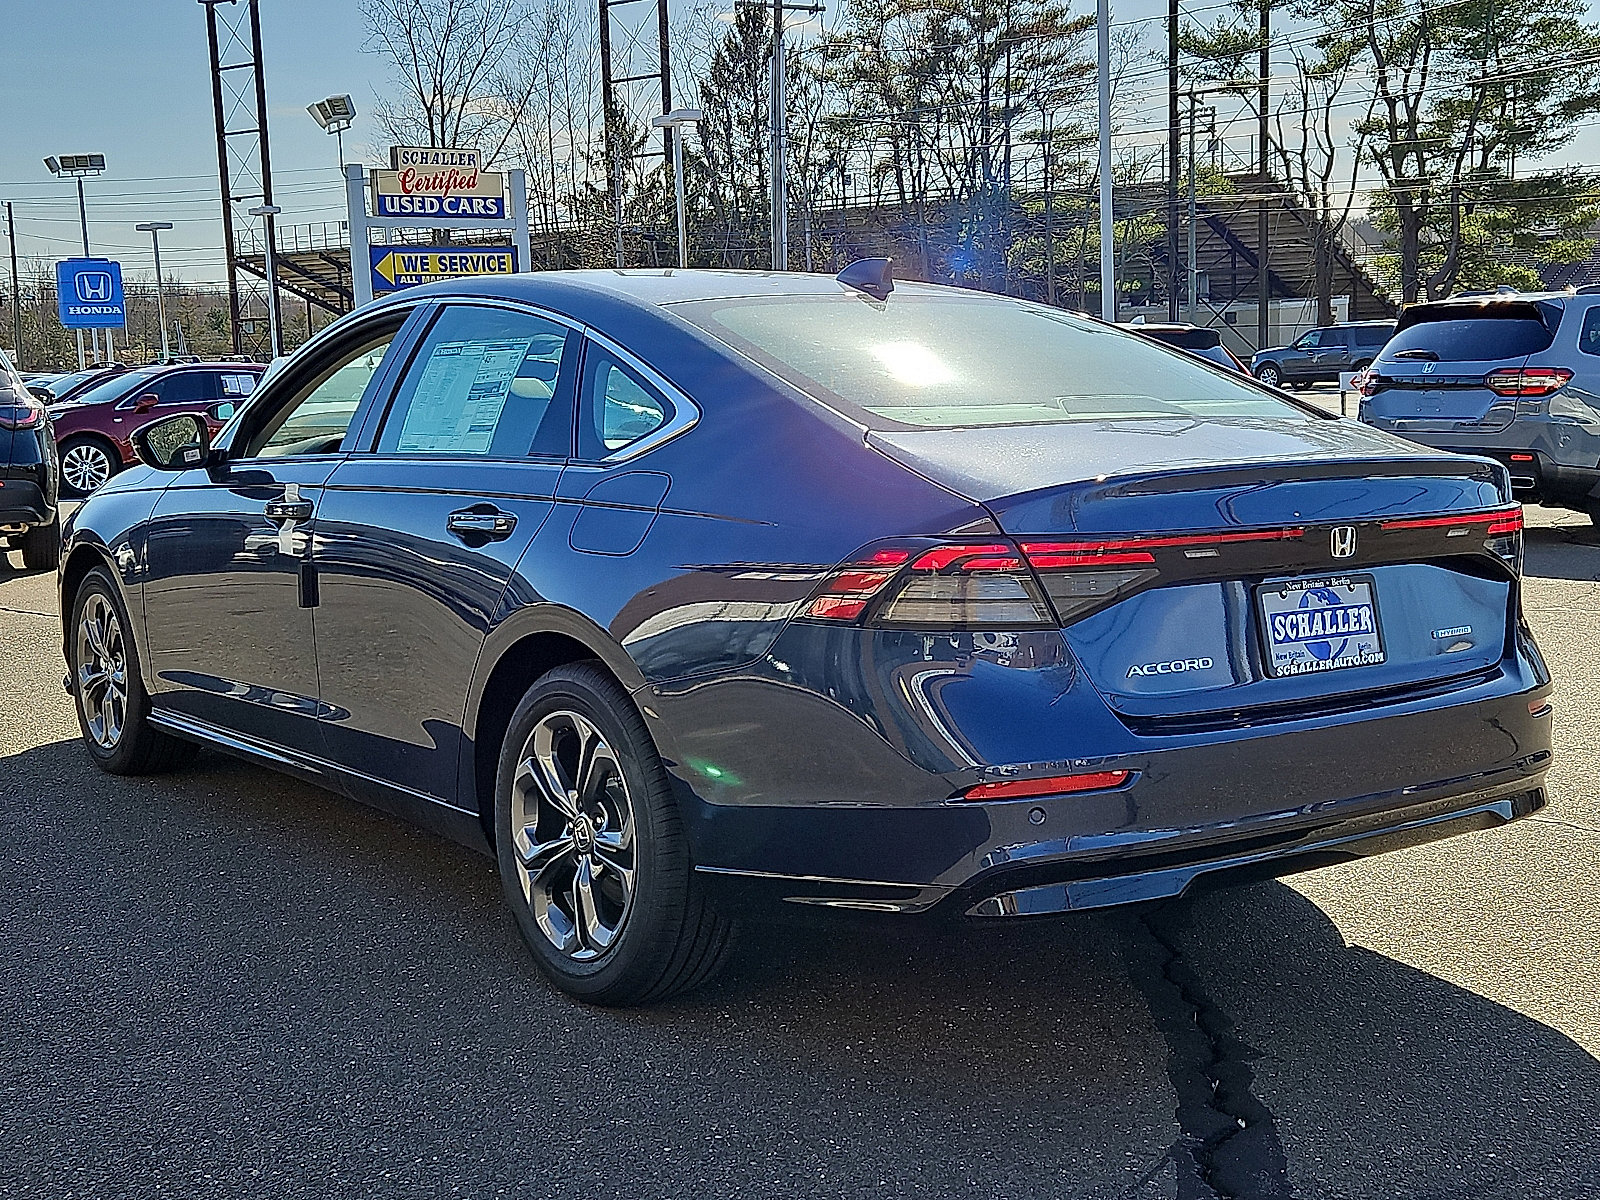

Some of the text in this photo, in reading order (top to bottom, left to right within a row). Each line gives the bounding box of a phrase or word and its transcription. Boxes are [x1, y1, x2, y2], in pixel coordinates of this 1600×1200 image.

[402, 151, 476, 166] SCHALLER
[398, 168, 478, 198] Certified
[385, 197, 498, 214] USED CARS
[402, 254, 507, 272] WE SERVICE
[400, 276, 419, 284] ALL
[68, 306, 122, 314] HONDA
[1285, 577, 1351, 591] New Britain Berlin
[1274, 606, 1372, 641] SCHALLER
[1126, 657, 1213, 678] ACCORD
[1276, 652, 1384, 676] SCHALLERAUTO.COM
